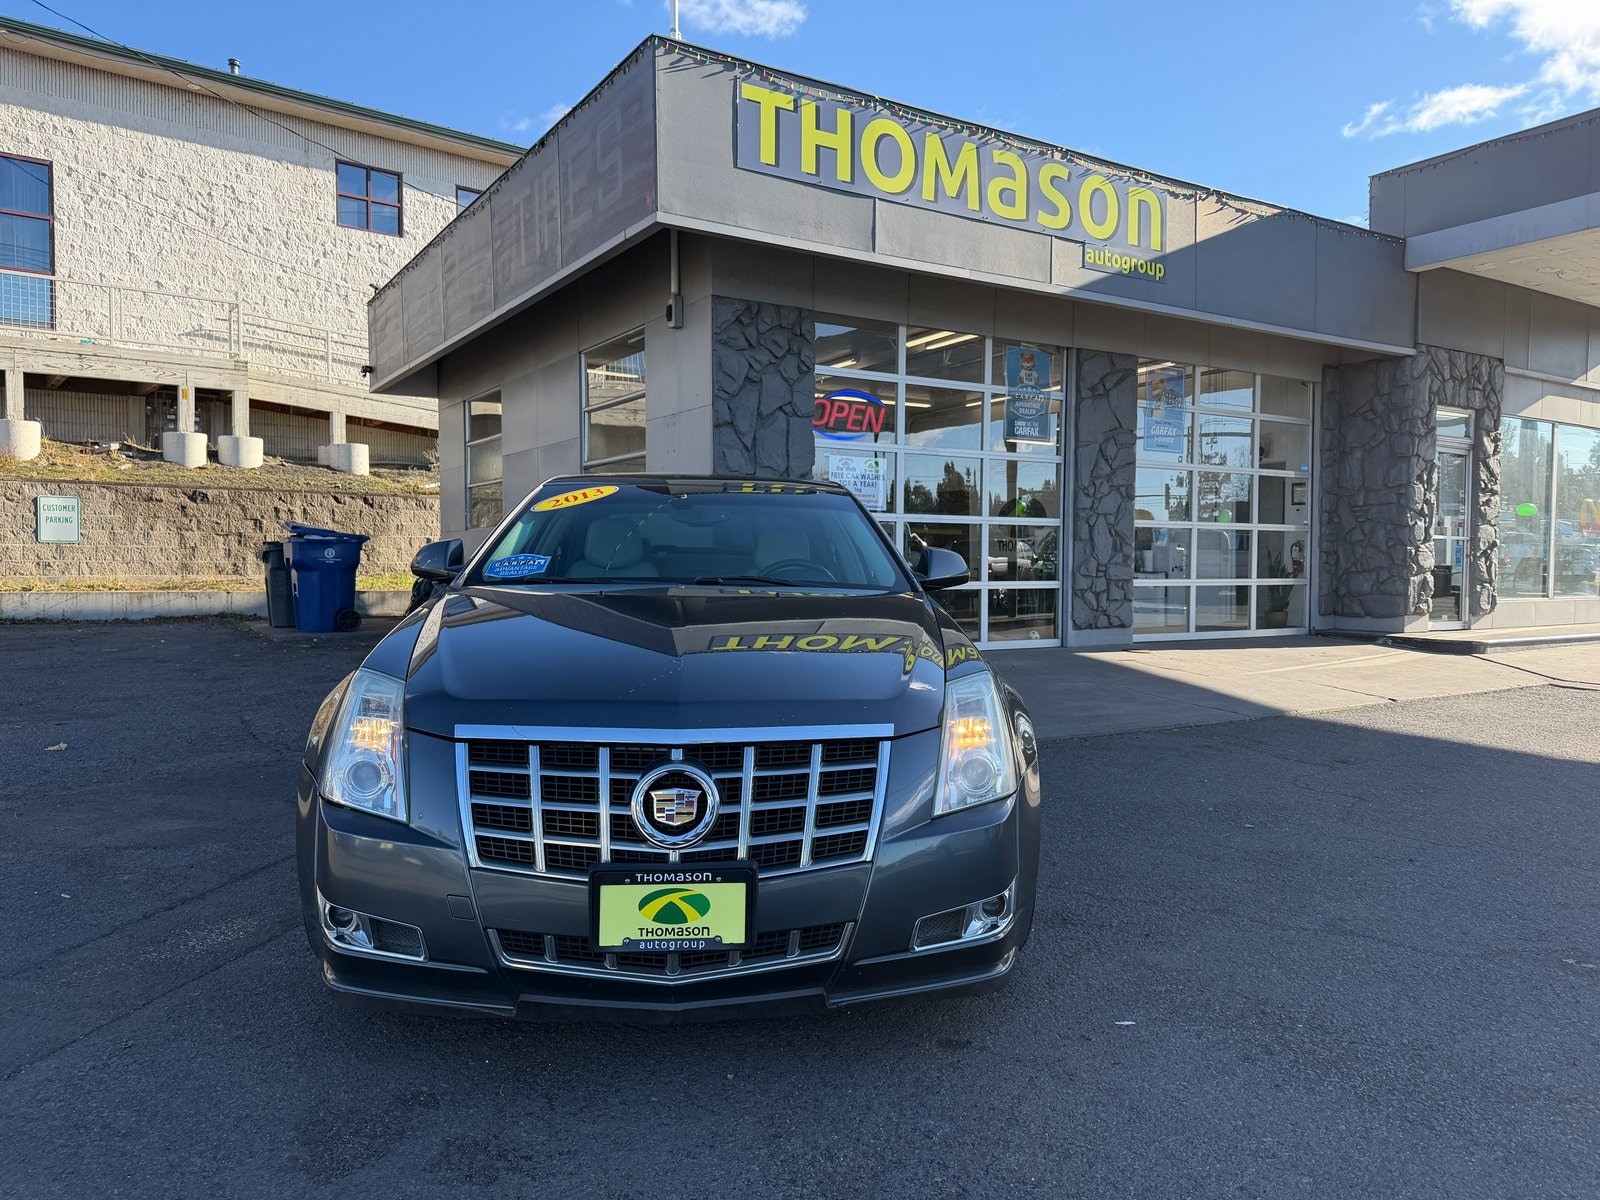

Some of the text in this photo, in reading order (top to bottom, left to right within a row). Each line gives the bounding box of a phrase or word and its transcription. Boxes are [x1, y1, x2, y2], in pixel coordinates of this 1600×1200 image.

[1086, 248, 1165, 281] autogroup
[812, 398, 887, 433] OPEN
[1014, 426, 1039, 436] CARFAX
[1150, 425, 1177, 436] CARFAX
[831, 471, 886, 481] FREE CAR WASHES
[548, 488, 605, 509] 2013
[42, 504, 76, 512] CUSTOMER
[45, 516, 73, 524] PARKING
[639, 940, 706, 950] autogroup
